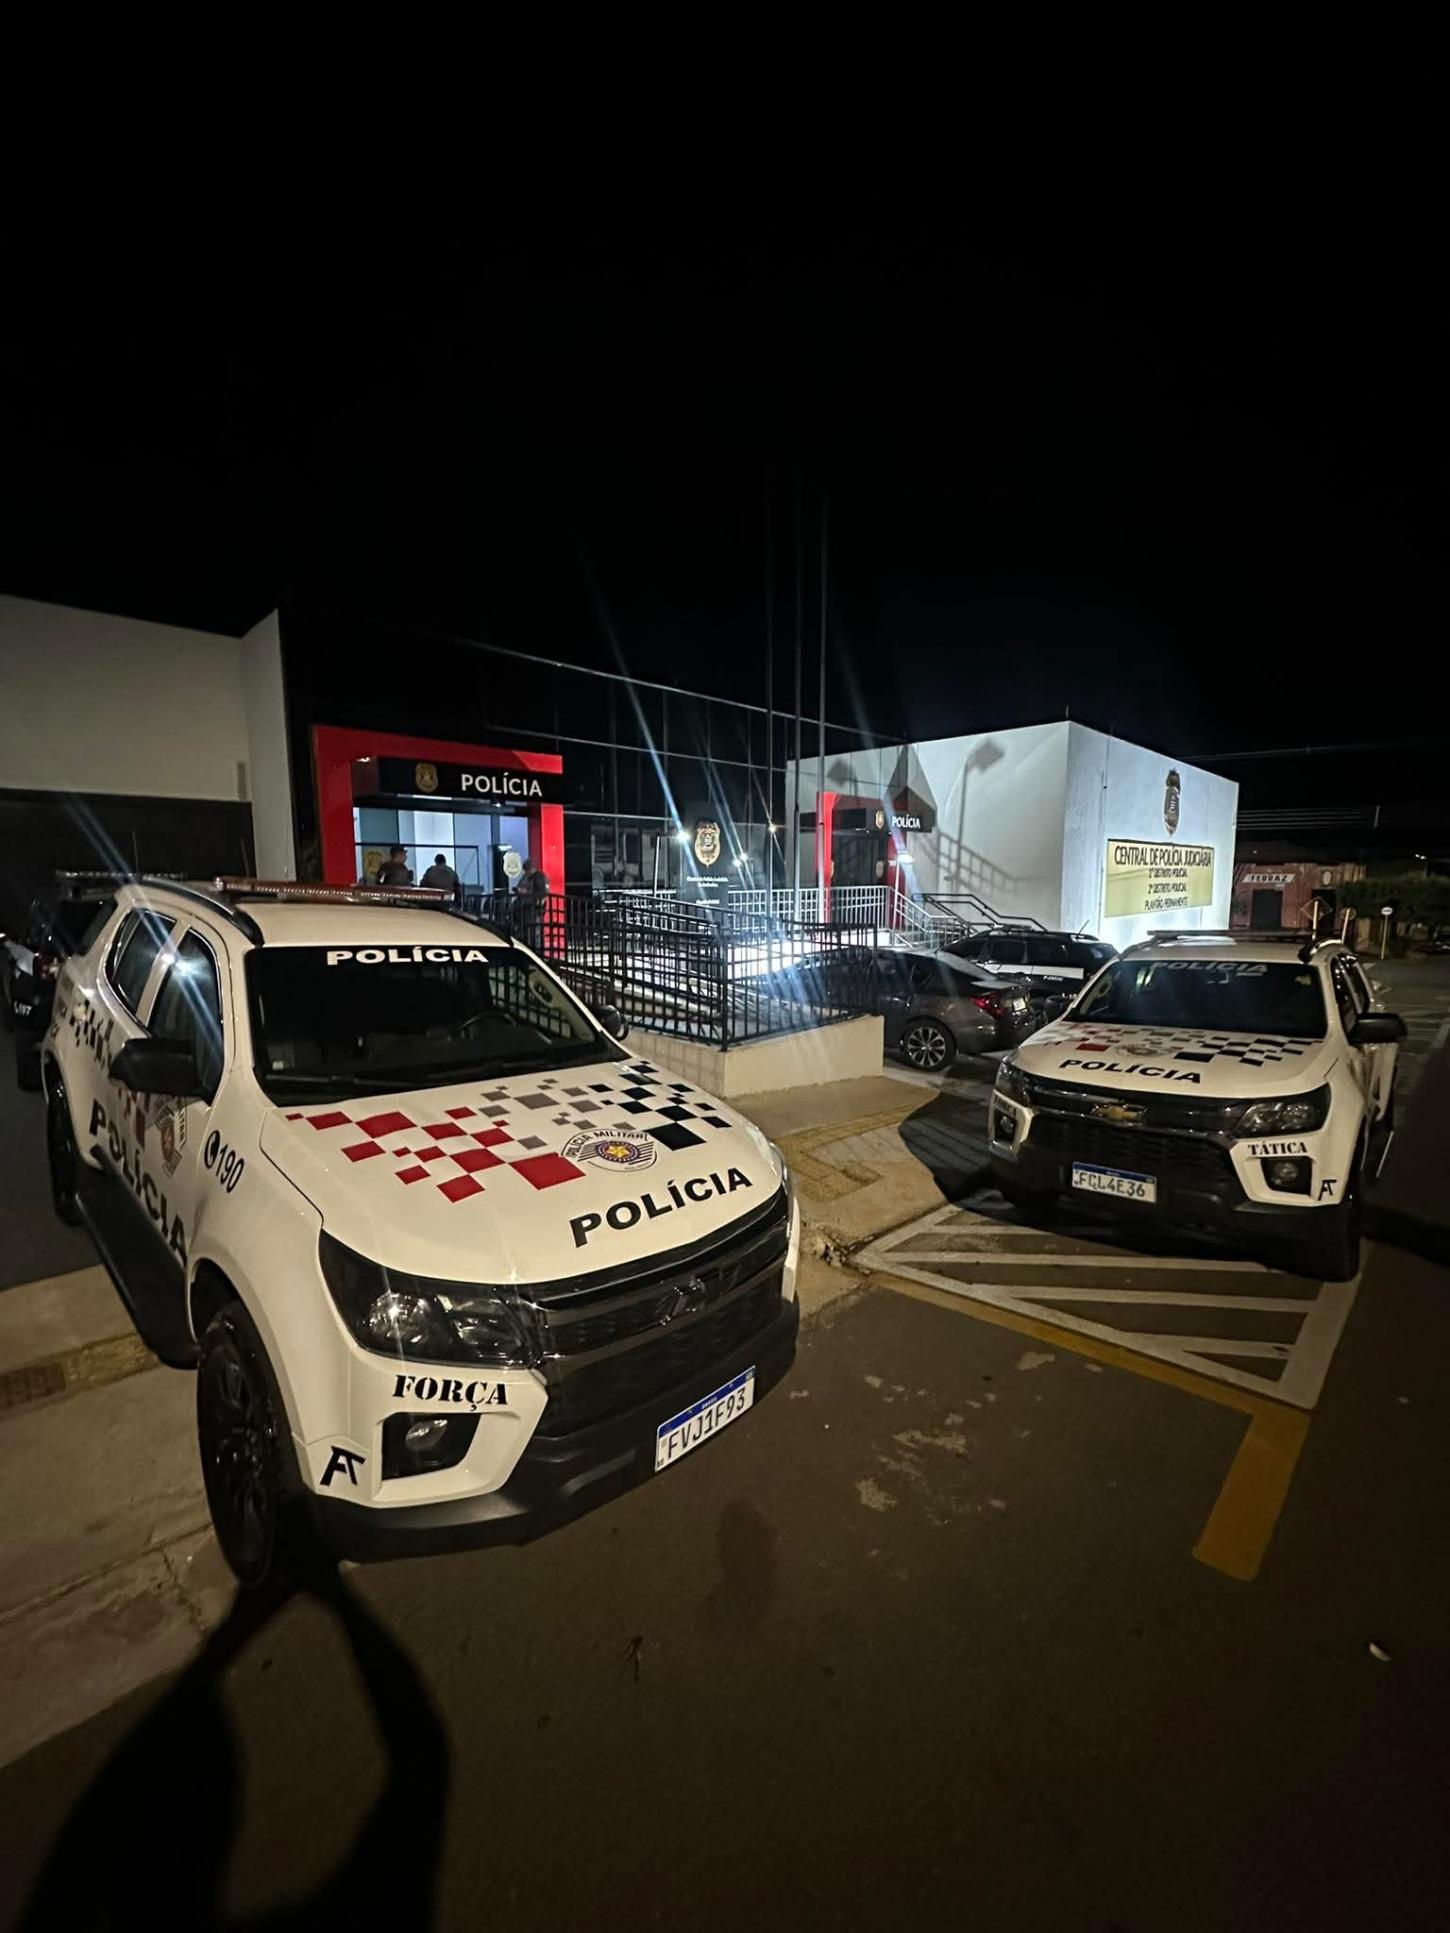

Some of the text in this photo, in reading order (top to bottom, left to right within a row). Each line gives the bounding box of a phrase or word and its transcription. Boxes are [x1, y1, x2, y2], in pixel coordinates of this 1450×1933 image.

[461, 772, 543, 797] POLÍCIA
[891, 814, 921, 829] POLÍCIA
[1114, 846, 1148, 865] CENTRAL
[1150, 848, 1159, 866] DE
[326, 946, 489, 966] POLÍCIA
[1248, 1141, 1307, 1155] TÁTICA
[215, 1143, 245, 1194] 190
[569, 1167, 753, 1248] POLÍCIA
[392, 1374, 508, 1411] FORÇA
[668, 1387, 746, 1459] FVJ1F93
